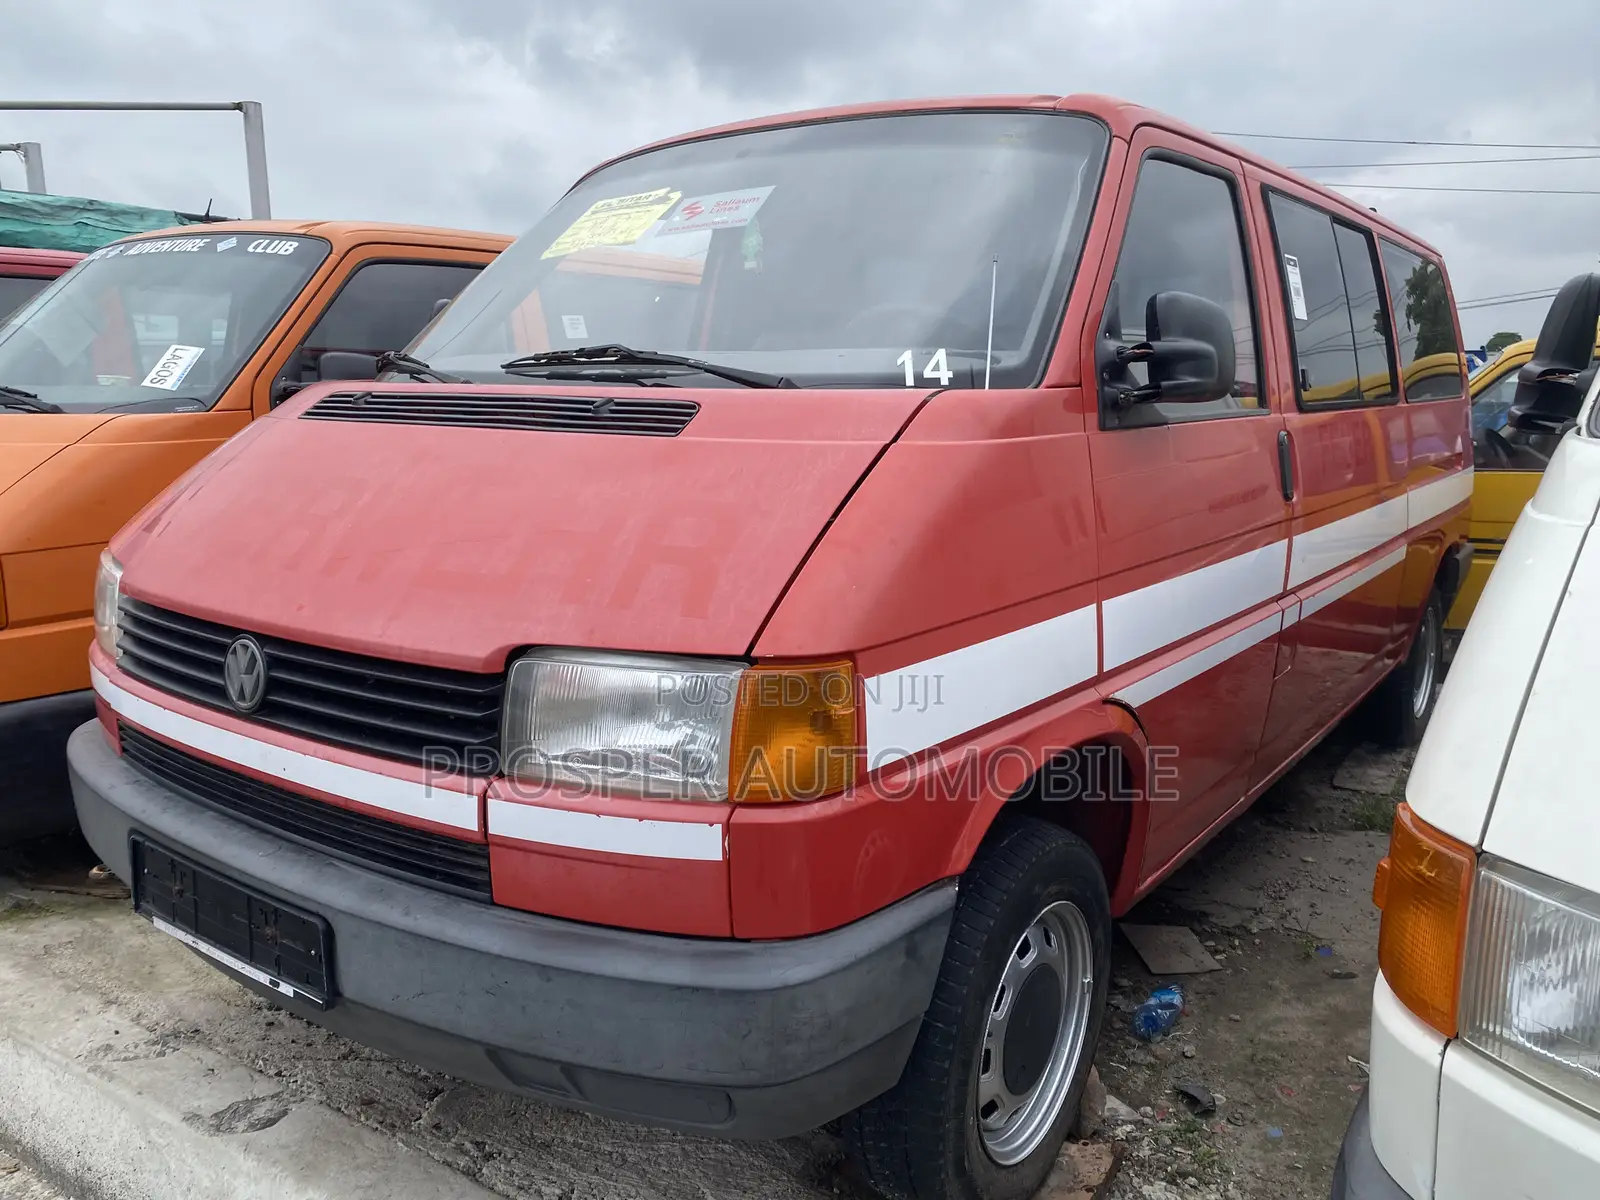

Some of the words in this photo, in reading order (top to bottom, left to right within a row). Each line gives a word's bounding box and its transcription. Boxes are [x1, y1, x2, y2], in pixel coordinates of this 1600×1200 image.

[123, 239, 211, 256] ADVENTURE
[247, 239, 299, 256] CLUB
[150, 347, 190, 385] LAGOS
[896, 348, 954, 387] 14
